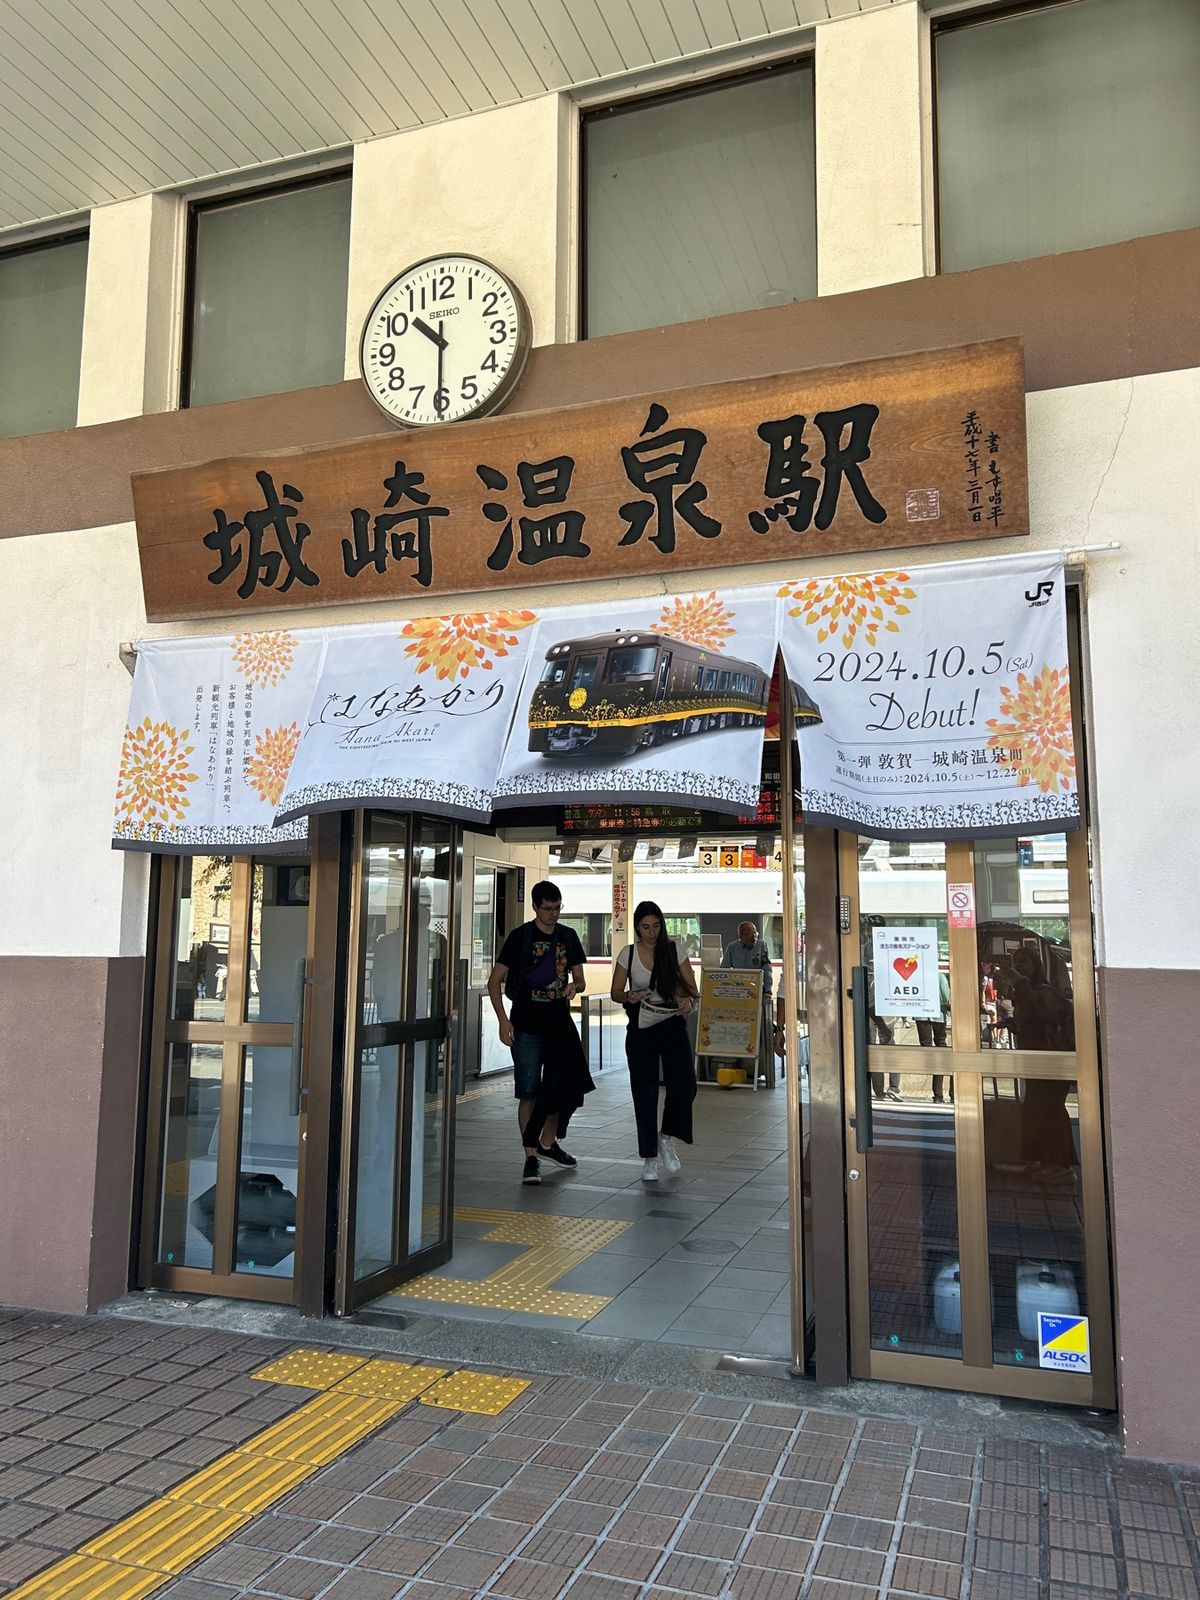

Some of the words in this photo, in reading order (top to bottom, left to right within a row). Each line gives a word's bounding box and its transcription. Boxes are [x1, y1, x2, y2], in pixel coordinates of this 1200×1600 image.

[409, 287, 426, 312] 11
[432, 275, 455, 301] 12
[468, 276, 473, 300] 1
[429, 307, 460, 320] SEIKO
[482, 292, 498, 317] 2
[386, 312, 408, 338] 10
[489, 319, 507, 345] 3
[379, 343, 396, 367] 9
[480, 350, 499, 373] 4
[388, 367, 405, 391] 8
[460, 375, 478, 400] 5
[409, 385, 425, 410] 7
[433, 387, 450, 412] 6
[203, 402, 888, 600] 城崎温泉駅
[1025, 581, 1055, 601] JR
[865, 687, 980, 732] Debut!
[703, 853, 713, 866] 3
[725, 854, 734, 866] 3
[893, 985, 920, 995] AED
[1043, 1316, 1062, 1324] Security
[1042, 1350, 1088, 1365] ALSOK
